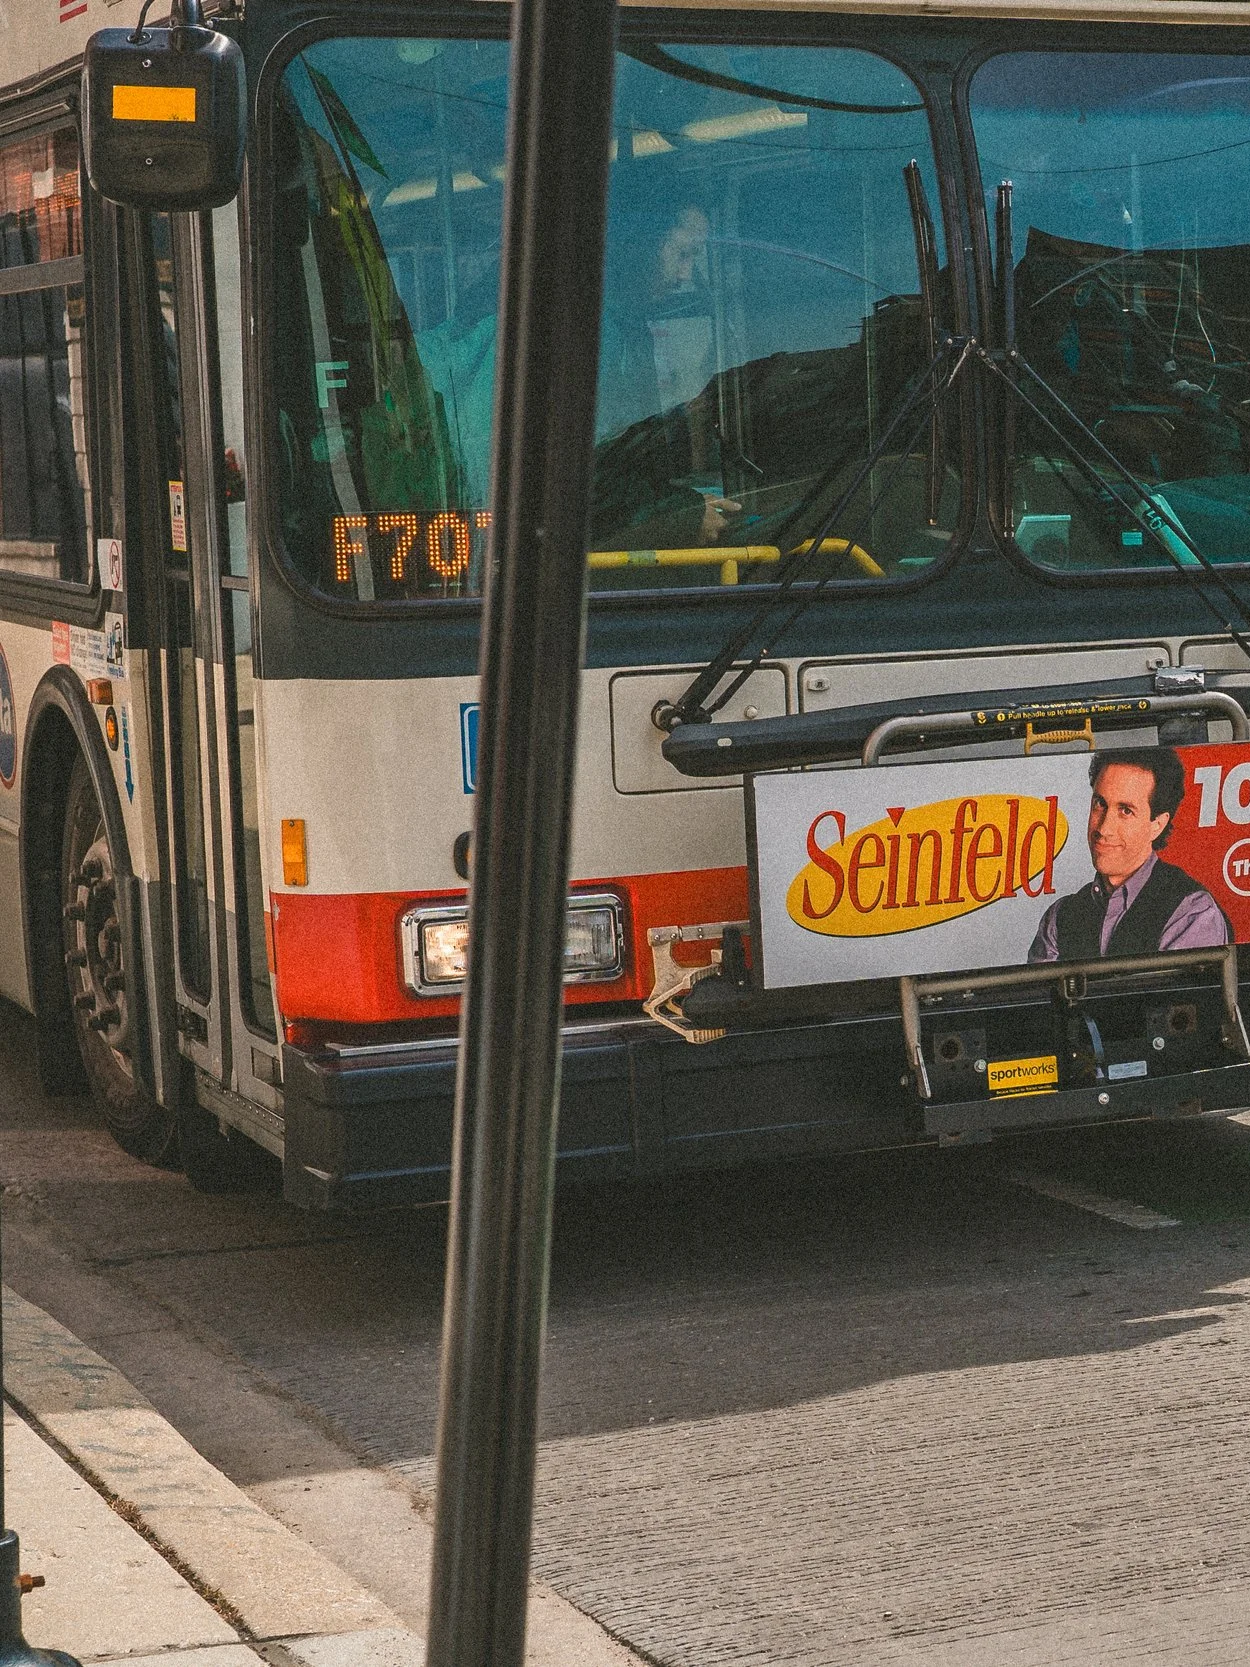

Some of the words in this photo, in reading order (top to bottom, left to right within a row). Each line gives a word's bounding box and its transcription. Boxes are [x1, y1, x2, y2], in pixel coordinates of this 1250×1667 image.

[333, 512, 493, 581] F70
[802, 796, 1059, 919] Seinfeld
[990, 1062, 1055, 1082] sportworks
